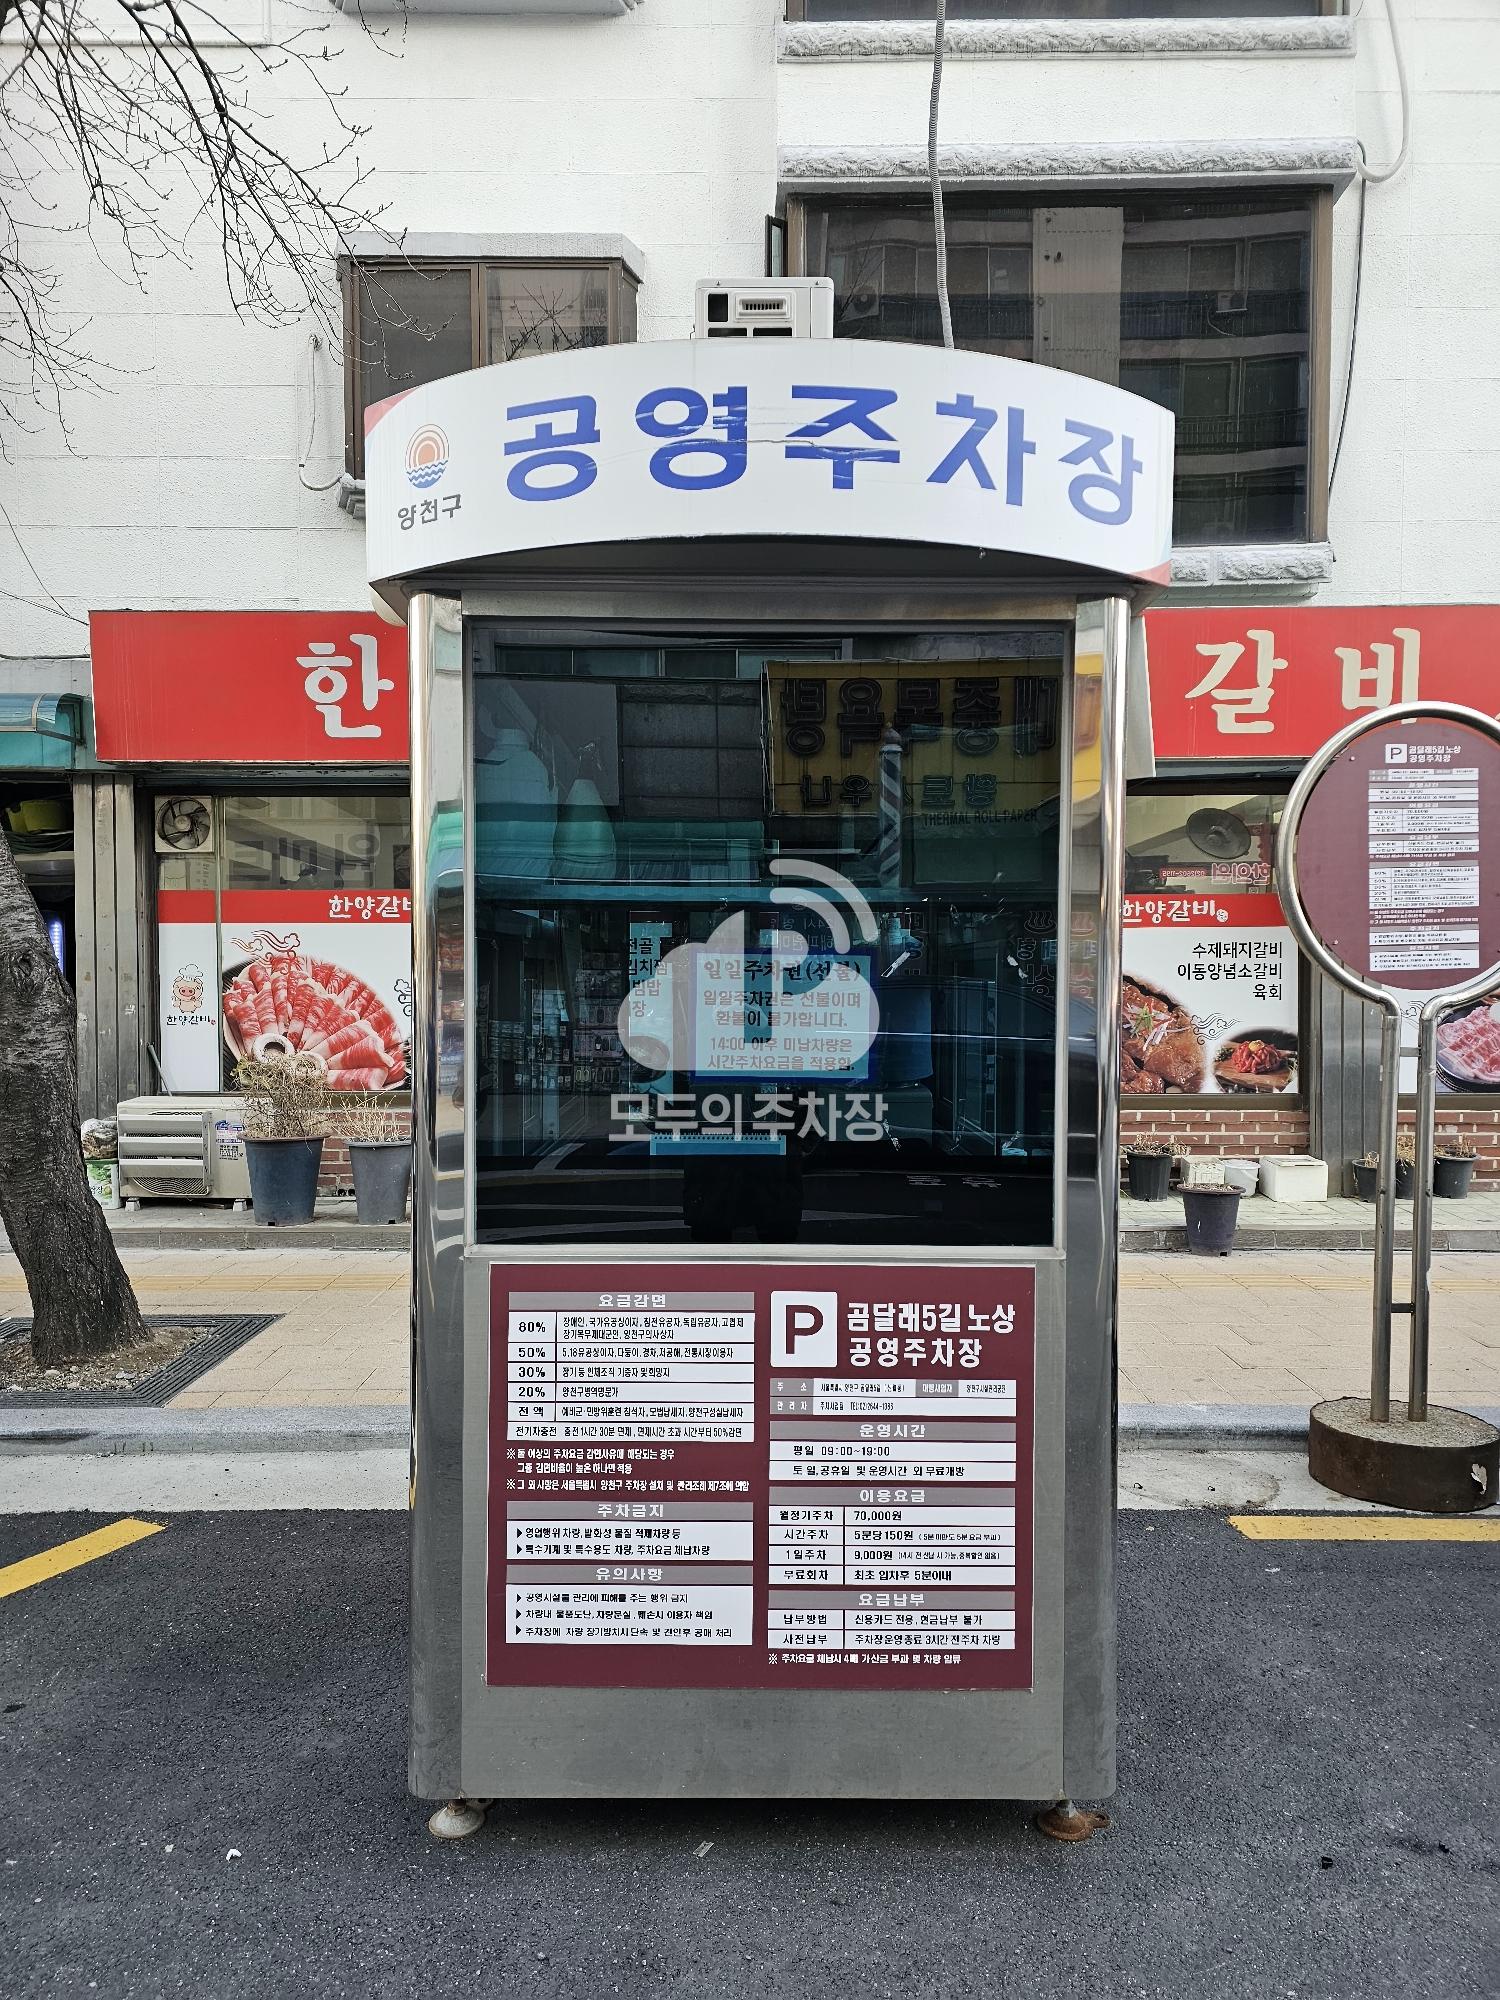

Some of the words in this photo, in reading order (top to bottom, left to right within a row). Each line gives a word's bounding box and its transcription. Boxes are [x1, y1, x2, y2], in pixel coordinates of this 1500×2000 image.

[504, 384, 1144, 526] 공영주차장
[396, 494, 463, 531] 양천구
[297, 633, 395, 739] 한
[1123, 899, 1216, 924] 한양갈비
[1191, 941, 1283, 960] 수제돼지갈비
[1177, 962, 1283, 981] 이동양념소갈비
[1252, 983, 1283, 1001] 육회
[799, 992, 862, 1009] 선불이며
[166, 1015, 211, 1027] 한양갈비
[716, 1010, 761, 1027] 환불이
[767, 1011, 849, 1028] 불가합니다.
[710, 1036, 746, 1051] 14:00
[751, 1036, 777, 1052] 이후
[783, 1037, 853, 1053] 미납차량은
[707, 1055, 804, 1070] 시간주차요금을
[597, 1293, 666, 1308] 요금감면
[847, 1302, 961, 1333] 곰달래5길
[967, 1302, 1016, 1333] 노상
[518, 1321, 546, 1333] 80%
[785, 1304, 824, 1355] P
[518, 1346, 546, 1358] 50%
[849, 1337, 983, 1368] 공영주차장
[518, 1366, 546, 1378] 30%
[518, 1386, 546, 1398] 20%
[859, 1423, 926, 1438] 운영시간
[553, 1448, 585, 1459] 주차요금
[659, 1448, 675, 1459] 경우
[793, 1445, 814, 1456] 평일
[856, 1465, 866, 1477] 및
[868, 1465, 908, 1477] 운영시간
[925, 1465, 965, 1477] 무료개방
[859, 1489, 926, 1503] 이용요금
[597, 1503, 664, 1518] 주차금지
[779, 1510, 834, 1521] 월정기주차
[853, 1510, 902, 1521] 70,000원
[783, 1528, 829, 1540] 시간주차
[854, 1530, 883, 1541] 5분당
[884, 1530, 914, 1541] 150원
[563, 1544, 572, 1556] 및
[574, 1544, 611, 1556] 특수용도
[636, 1544, 672, 1556] 주차요금
[854, 1550, 893, 1561] 9,000원
[595, 1567, 664, 1582] 유의사항
[784, 1569, 829, 1581] 무료회차
[854, 1570, 875, 1581] 최초
[572, 1593, 599, 1604] 관리에
[629, 1593, 647, 1604] 주는
[650, 1593, 668, 1604] 행위
[858, 1593, 925, 1607] 요금납부
[525, 1609, 552, 1620] 차량내
[666, 1609, 693, 1620] 이용자
[695, 1609, 713, 1620] 책임
[783, 1614, 827, 1625] 납부방법
[854, 1614, 893, 1626] 신용카드
[920, 1614, 958, 1626] 현금납부
[963, 1614, 983, 1626] 불가
[715, 1627, 732, 1637] 처리
[782, 1633, 828, 1645] 사전납부
[781, 1653, 815, 1664] 주차요금
[861, 1653, 889, 1664] 가산금
[923, 1653, 942, 1664] 차량
